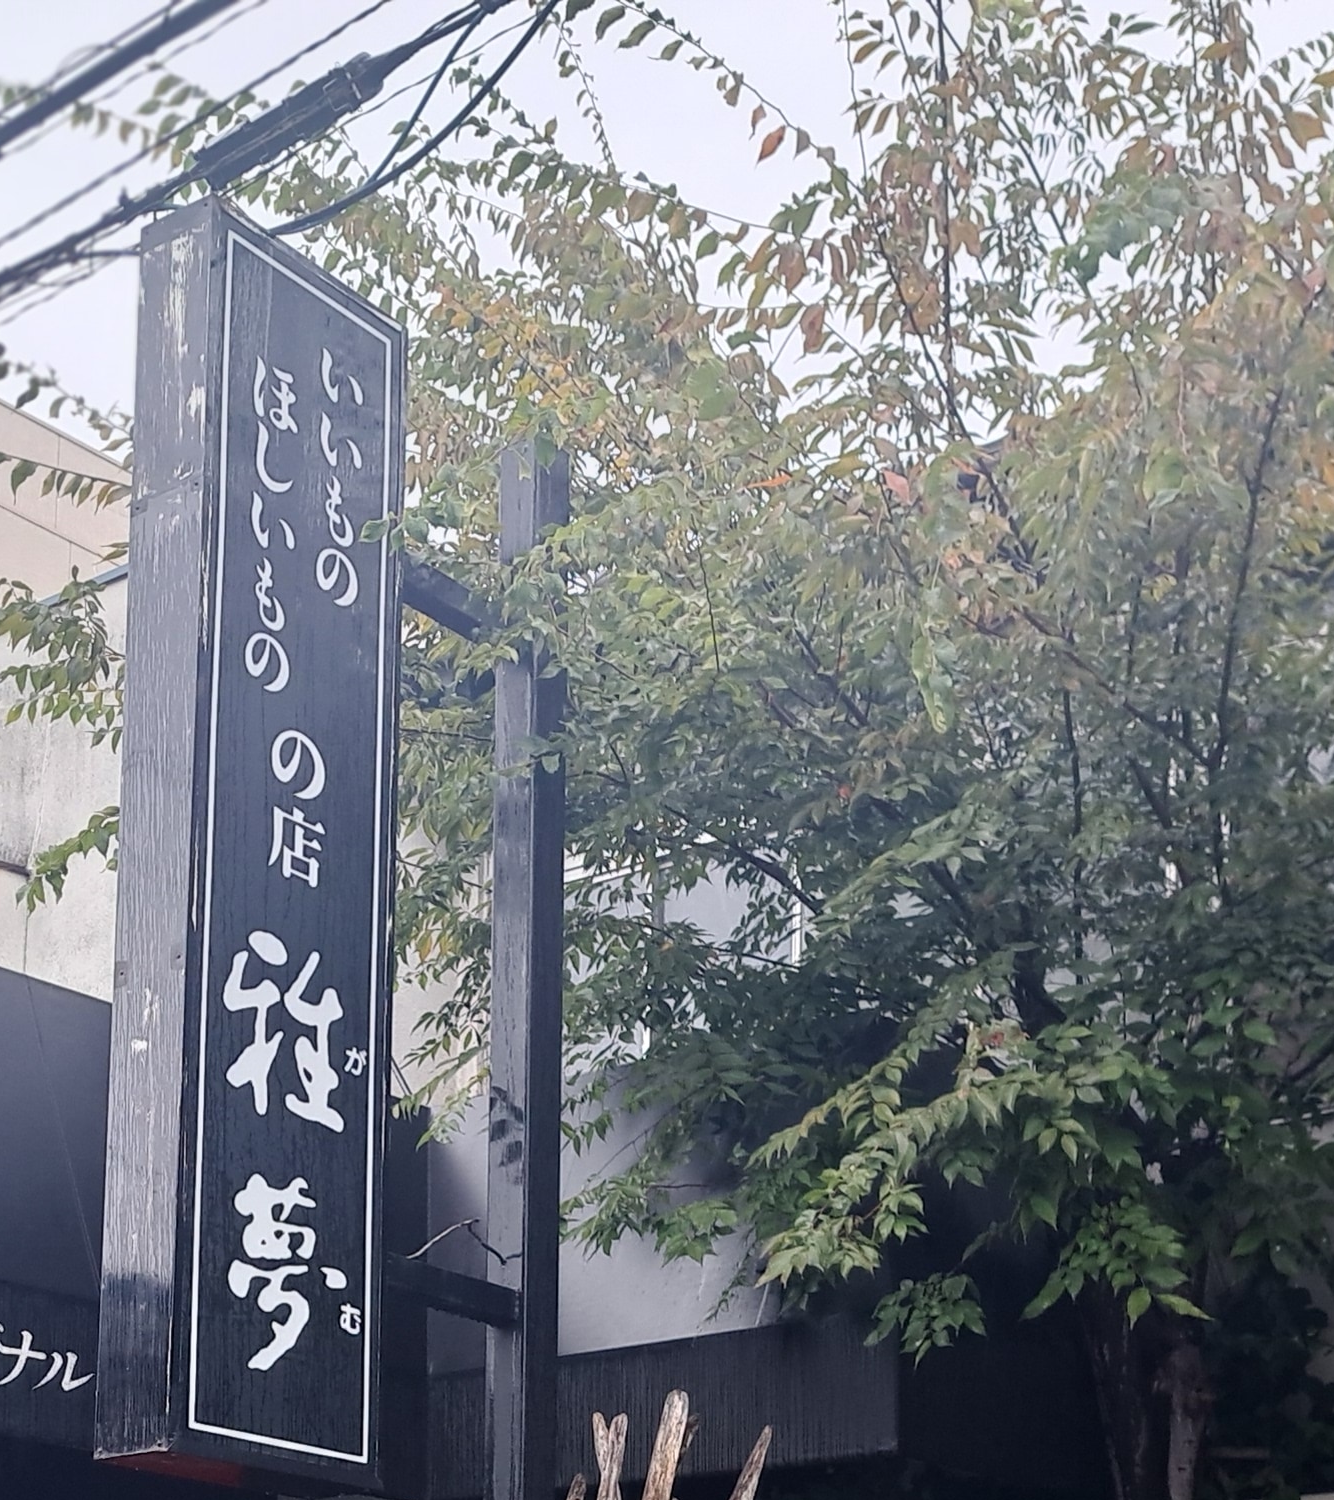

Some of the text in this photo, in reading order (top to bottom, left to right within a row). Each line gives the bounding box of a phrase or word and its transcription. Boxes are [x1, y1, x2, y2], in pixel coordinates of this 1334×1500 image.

[244, 354, 298, 693] ほしいもの
[315, 347, 364, 608] いいもの
[268, 728, 327, 889] の店
